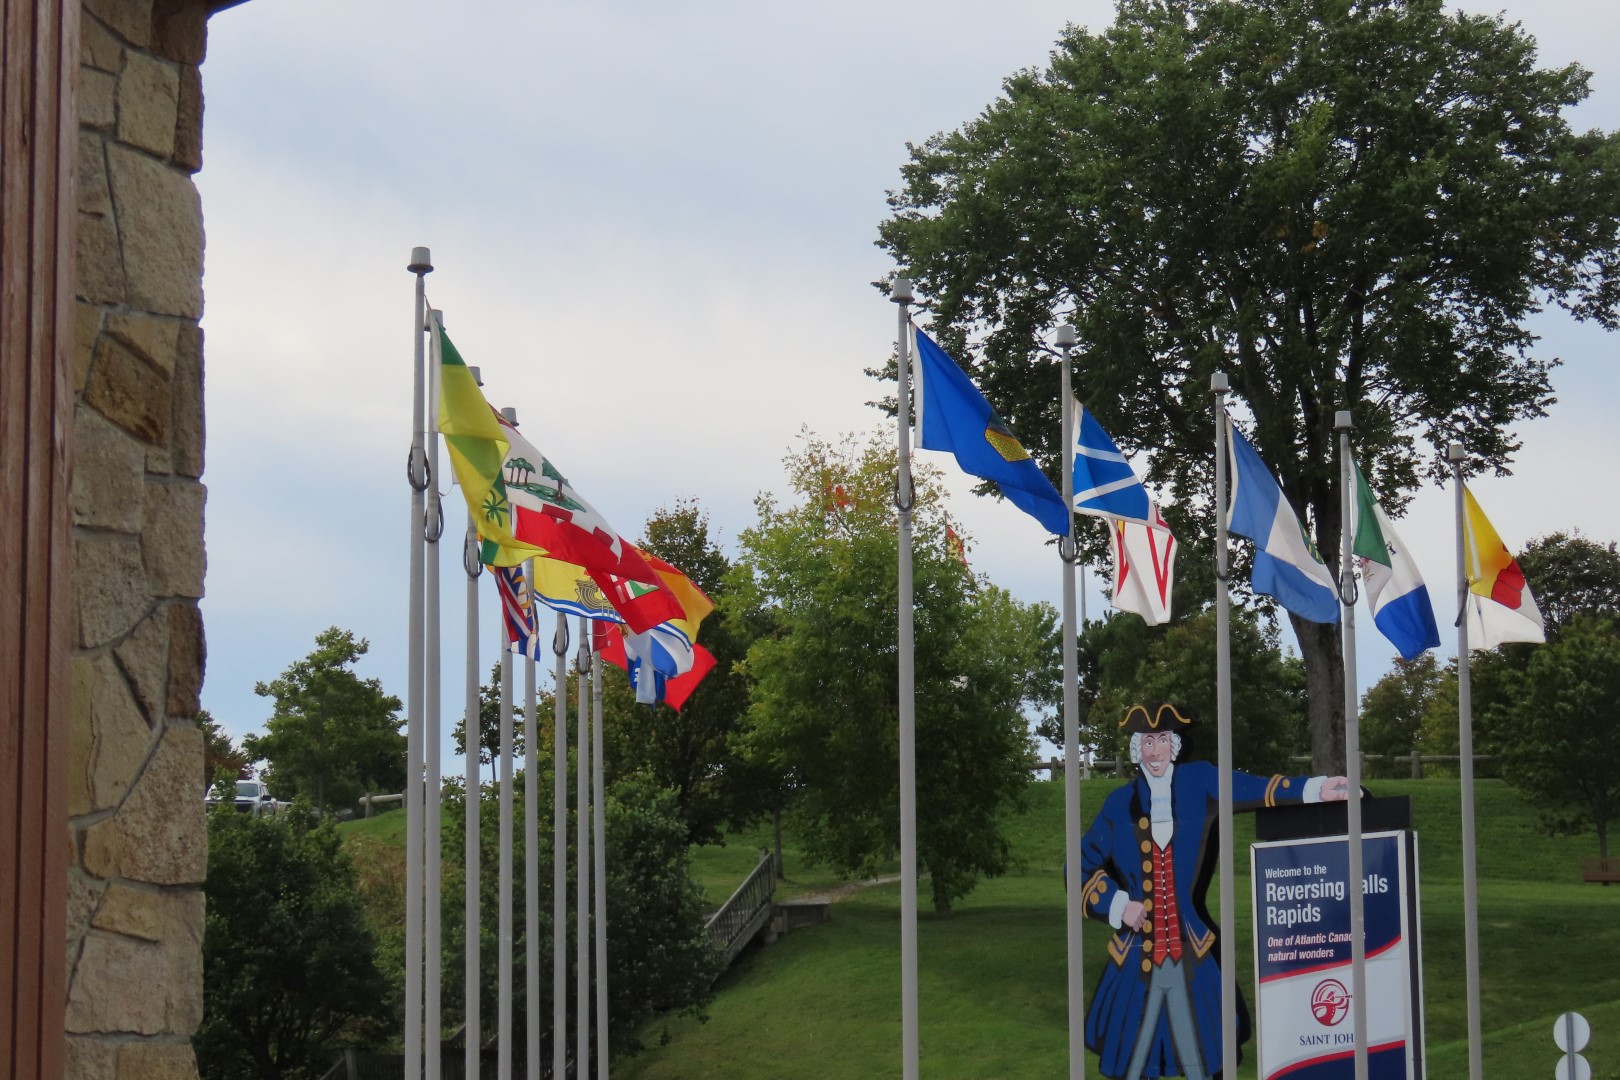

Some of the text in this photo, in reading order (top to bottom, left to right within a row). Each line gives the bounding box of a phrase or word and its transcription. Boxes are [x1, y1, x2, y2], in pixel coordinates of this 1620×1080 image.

[1265, 865, 1327, 879] Welcome to the
[1266, 874, 1389, 902] Reversing alls
[1266, 903, 1321, 928] Rapids
[1267, 931, 1366, 948] One of Atlantic Cana
[1267, 948, 1334, 962] natural wonders
[1299, 1033, 1354, 1046] SAINT JOH
